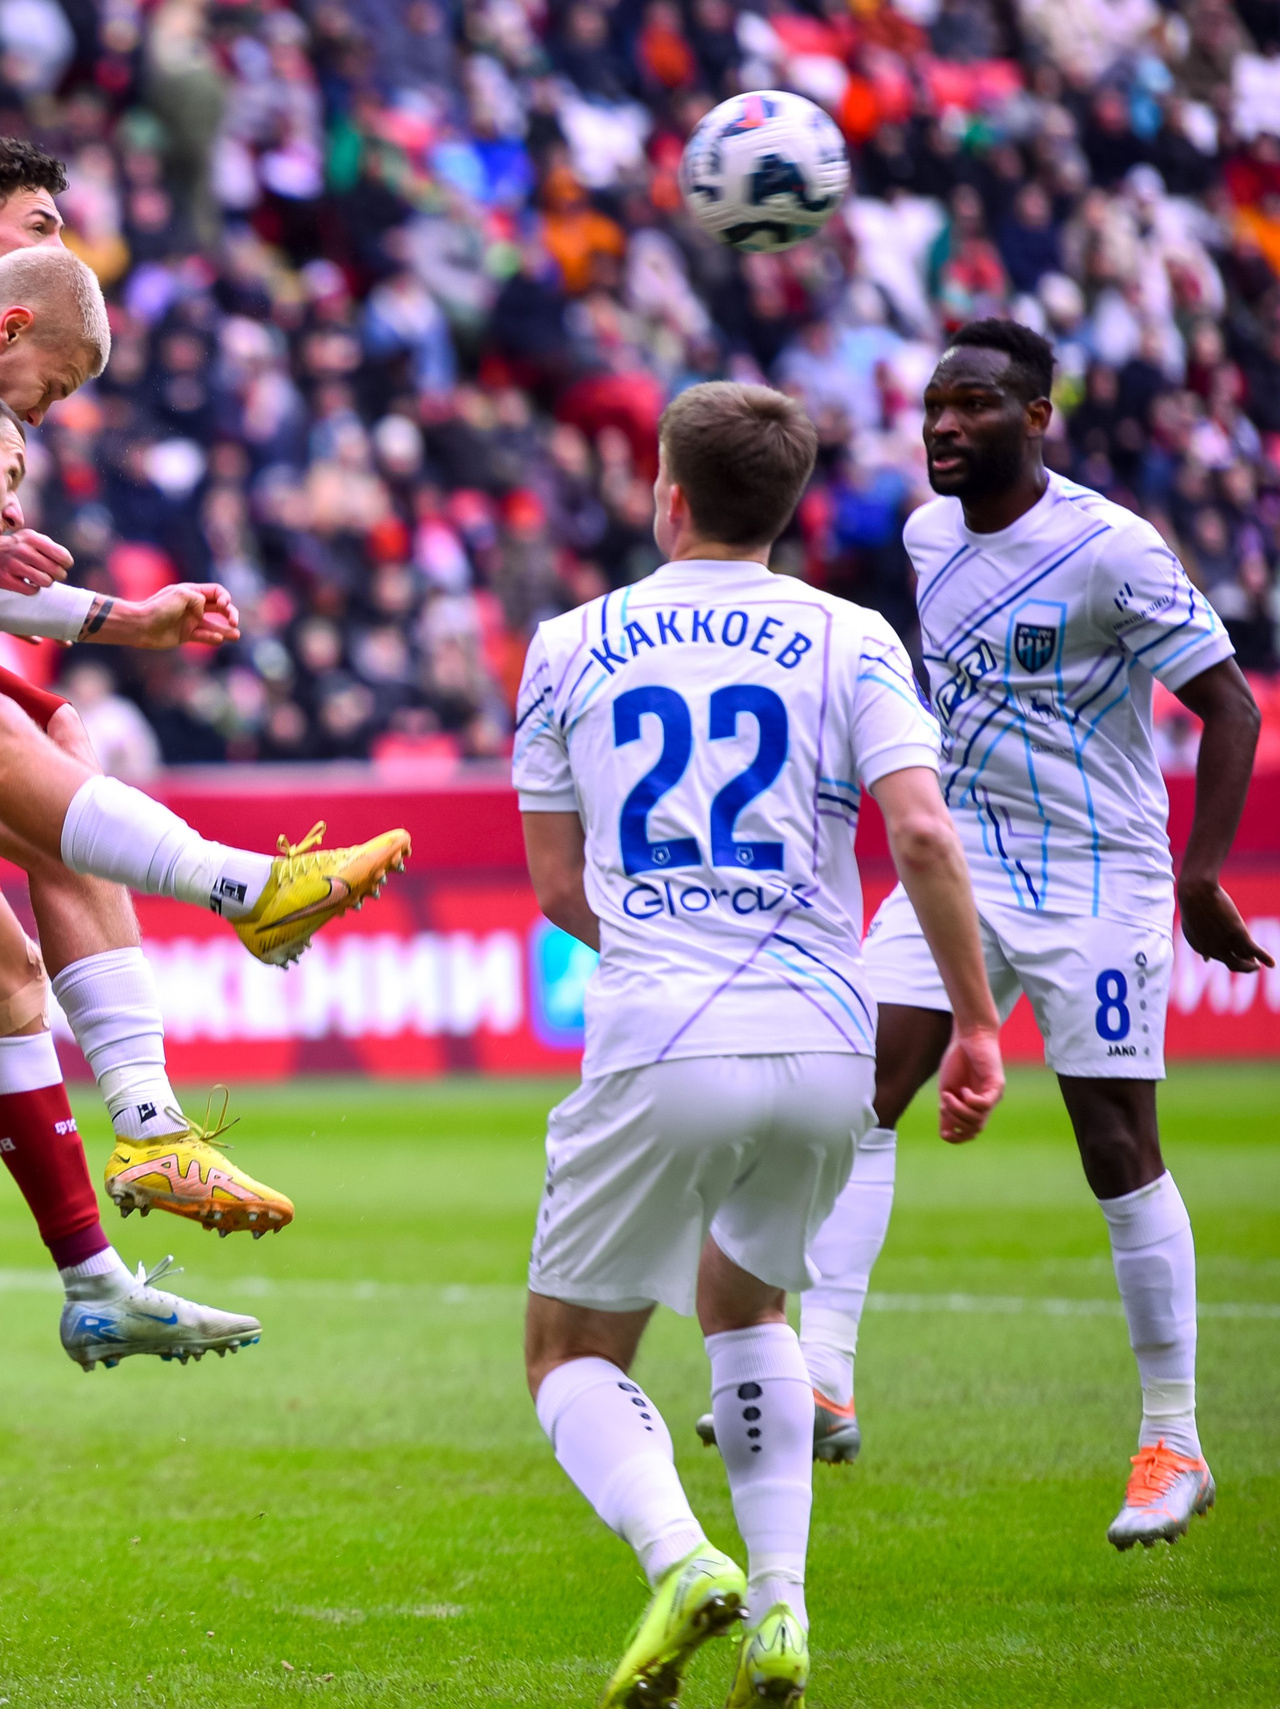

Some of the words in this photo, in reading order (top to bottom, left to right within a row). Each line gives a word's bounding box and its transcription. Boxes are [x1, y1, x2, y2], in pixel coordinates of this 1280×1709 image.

[591, 609, 813, 677] КАККОЕВ
[612, 684, 790, 877] 22
[1095, 968, 1131, 1042] 8
[1106, 1045, 1137, 1057] JAKO
